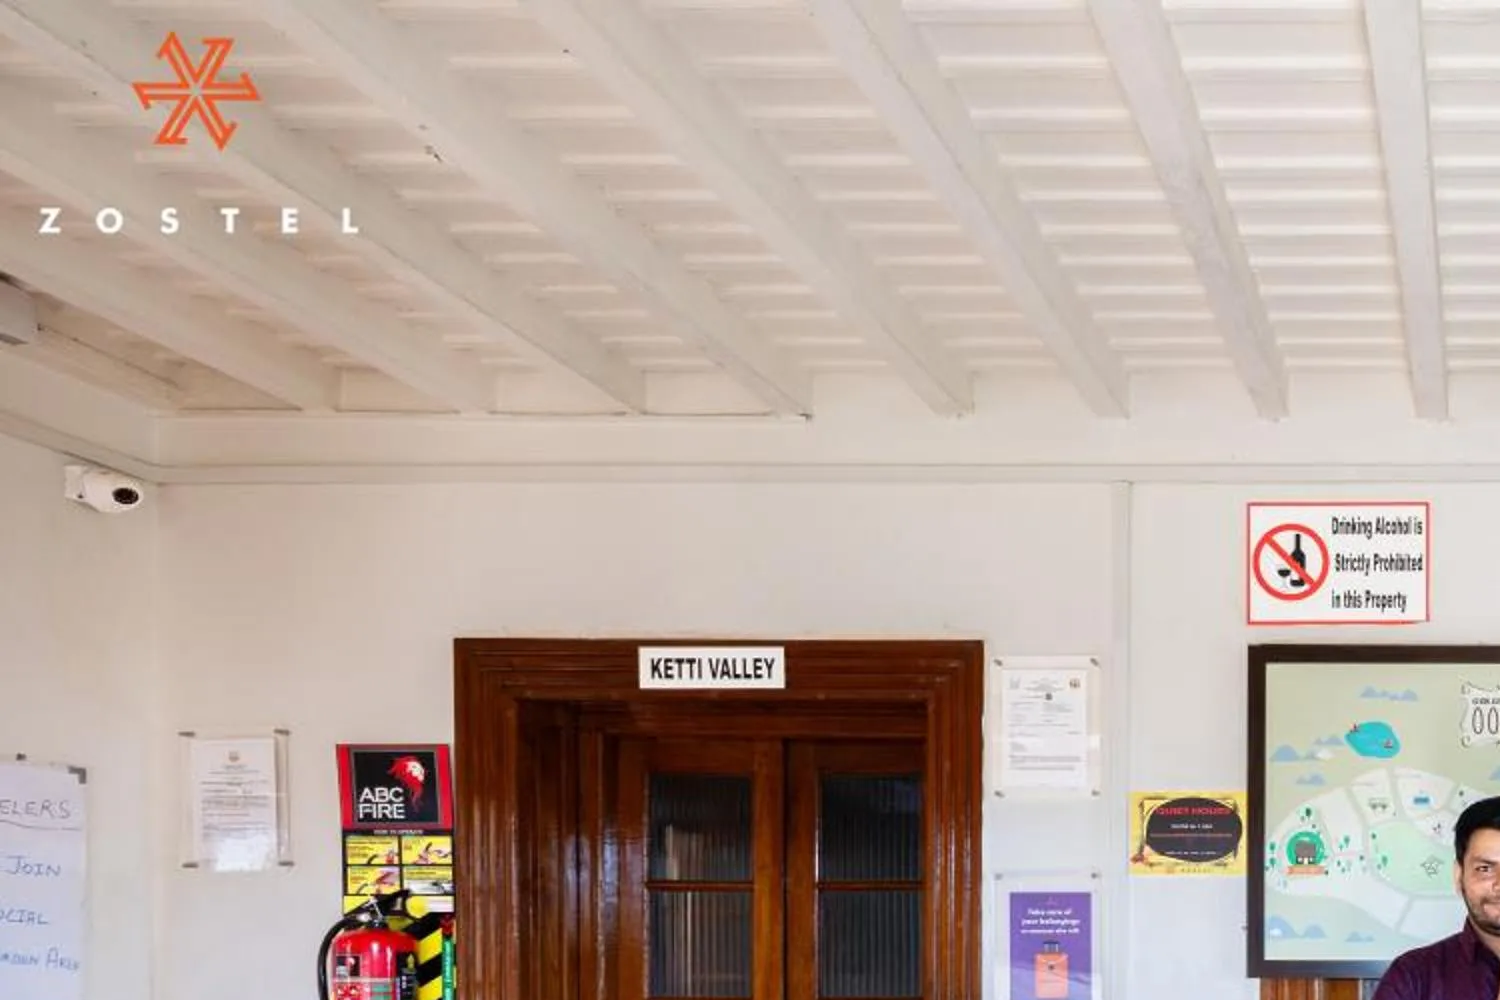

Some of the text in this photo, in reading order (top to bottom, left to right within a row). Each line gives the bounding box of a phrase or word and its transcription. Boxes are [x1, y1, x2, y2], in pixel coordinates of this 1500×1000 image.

[1331, 516, 1423, 540] Drinking Alcohol is
[1335, 553, 1423, 576] Strictly Prohibited
[1331, 590, 1407, 613] in this Property
[650, 657, 775, 679] KETTI VALLEY
[360, 787, 404, 803] ABC
[358, 803, 406, 819] FIRE
[4, 855, 62, 877] JOIN
